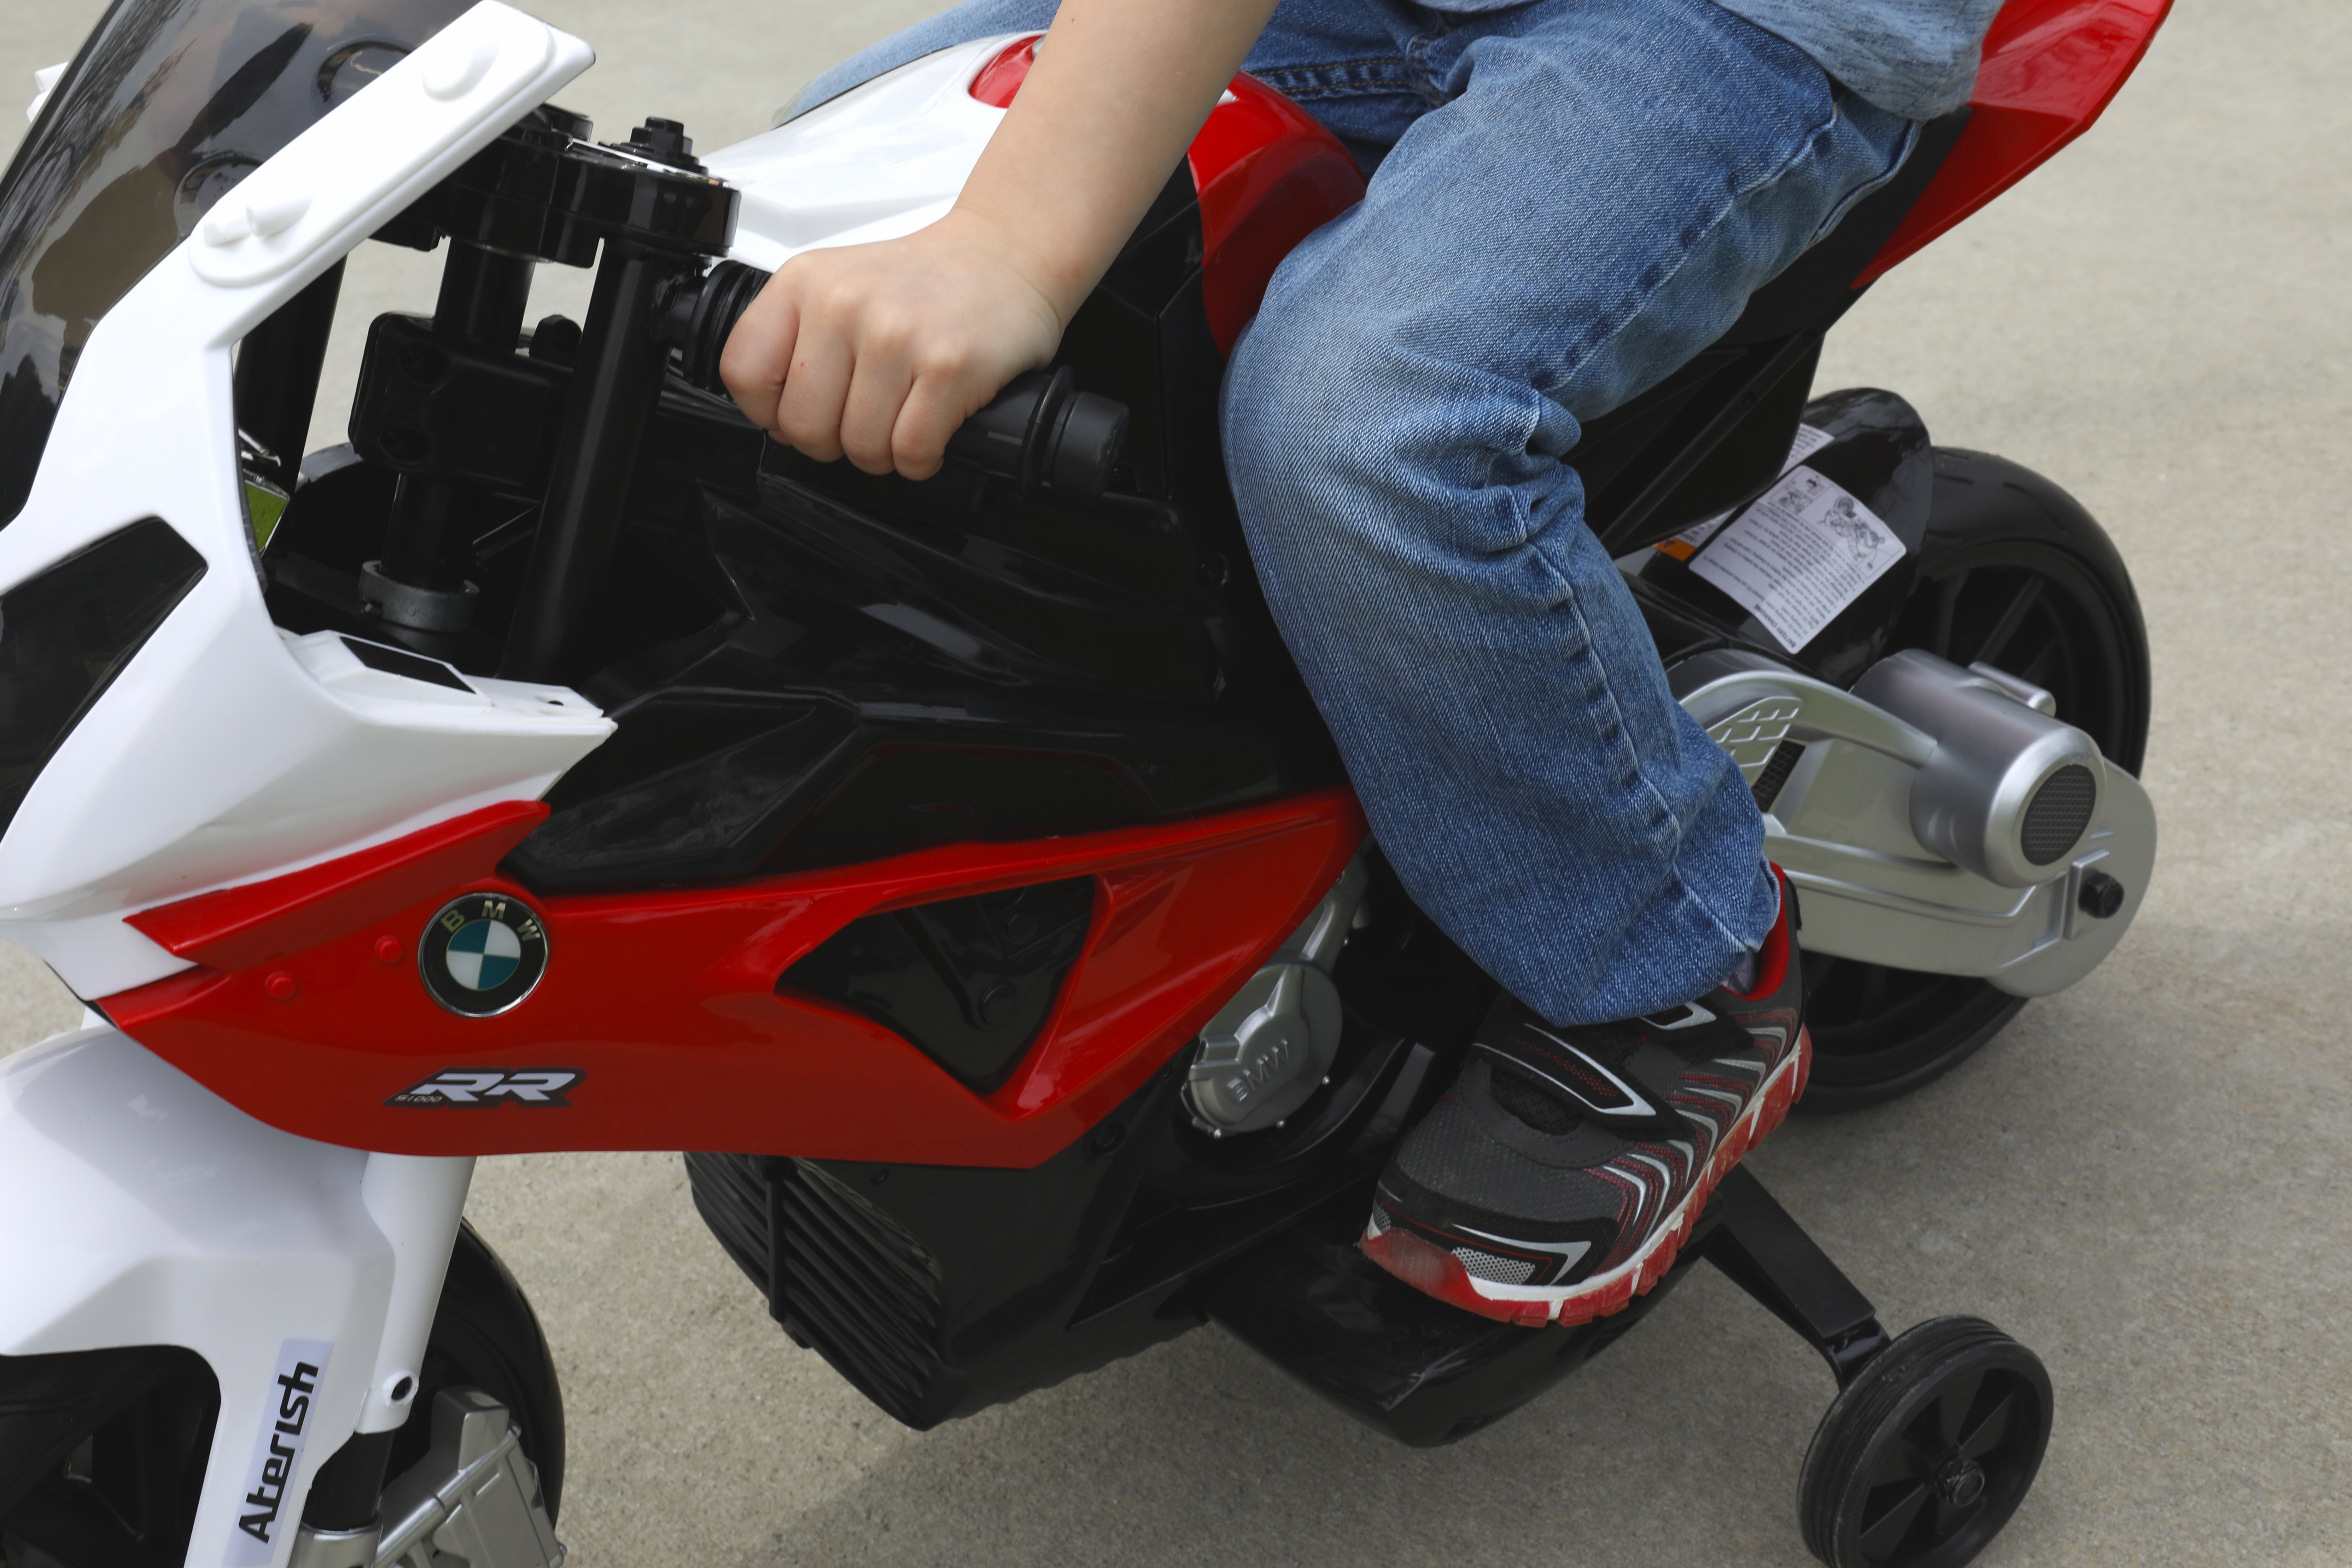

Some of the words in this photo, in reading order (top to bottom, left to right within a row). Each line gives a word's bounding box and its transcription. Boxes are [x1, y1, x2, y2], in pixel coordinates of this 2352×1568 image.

[440, 900, 541, 941] BMW
[409, 1073, 576, 1102] RR
[1227, 1039, 1291, 1102] BMW
